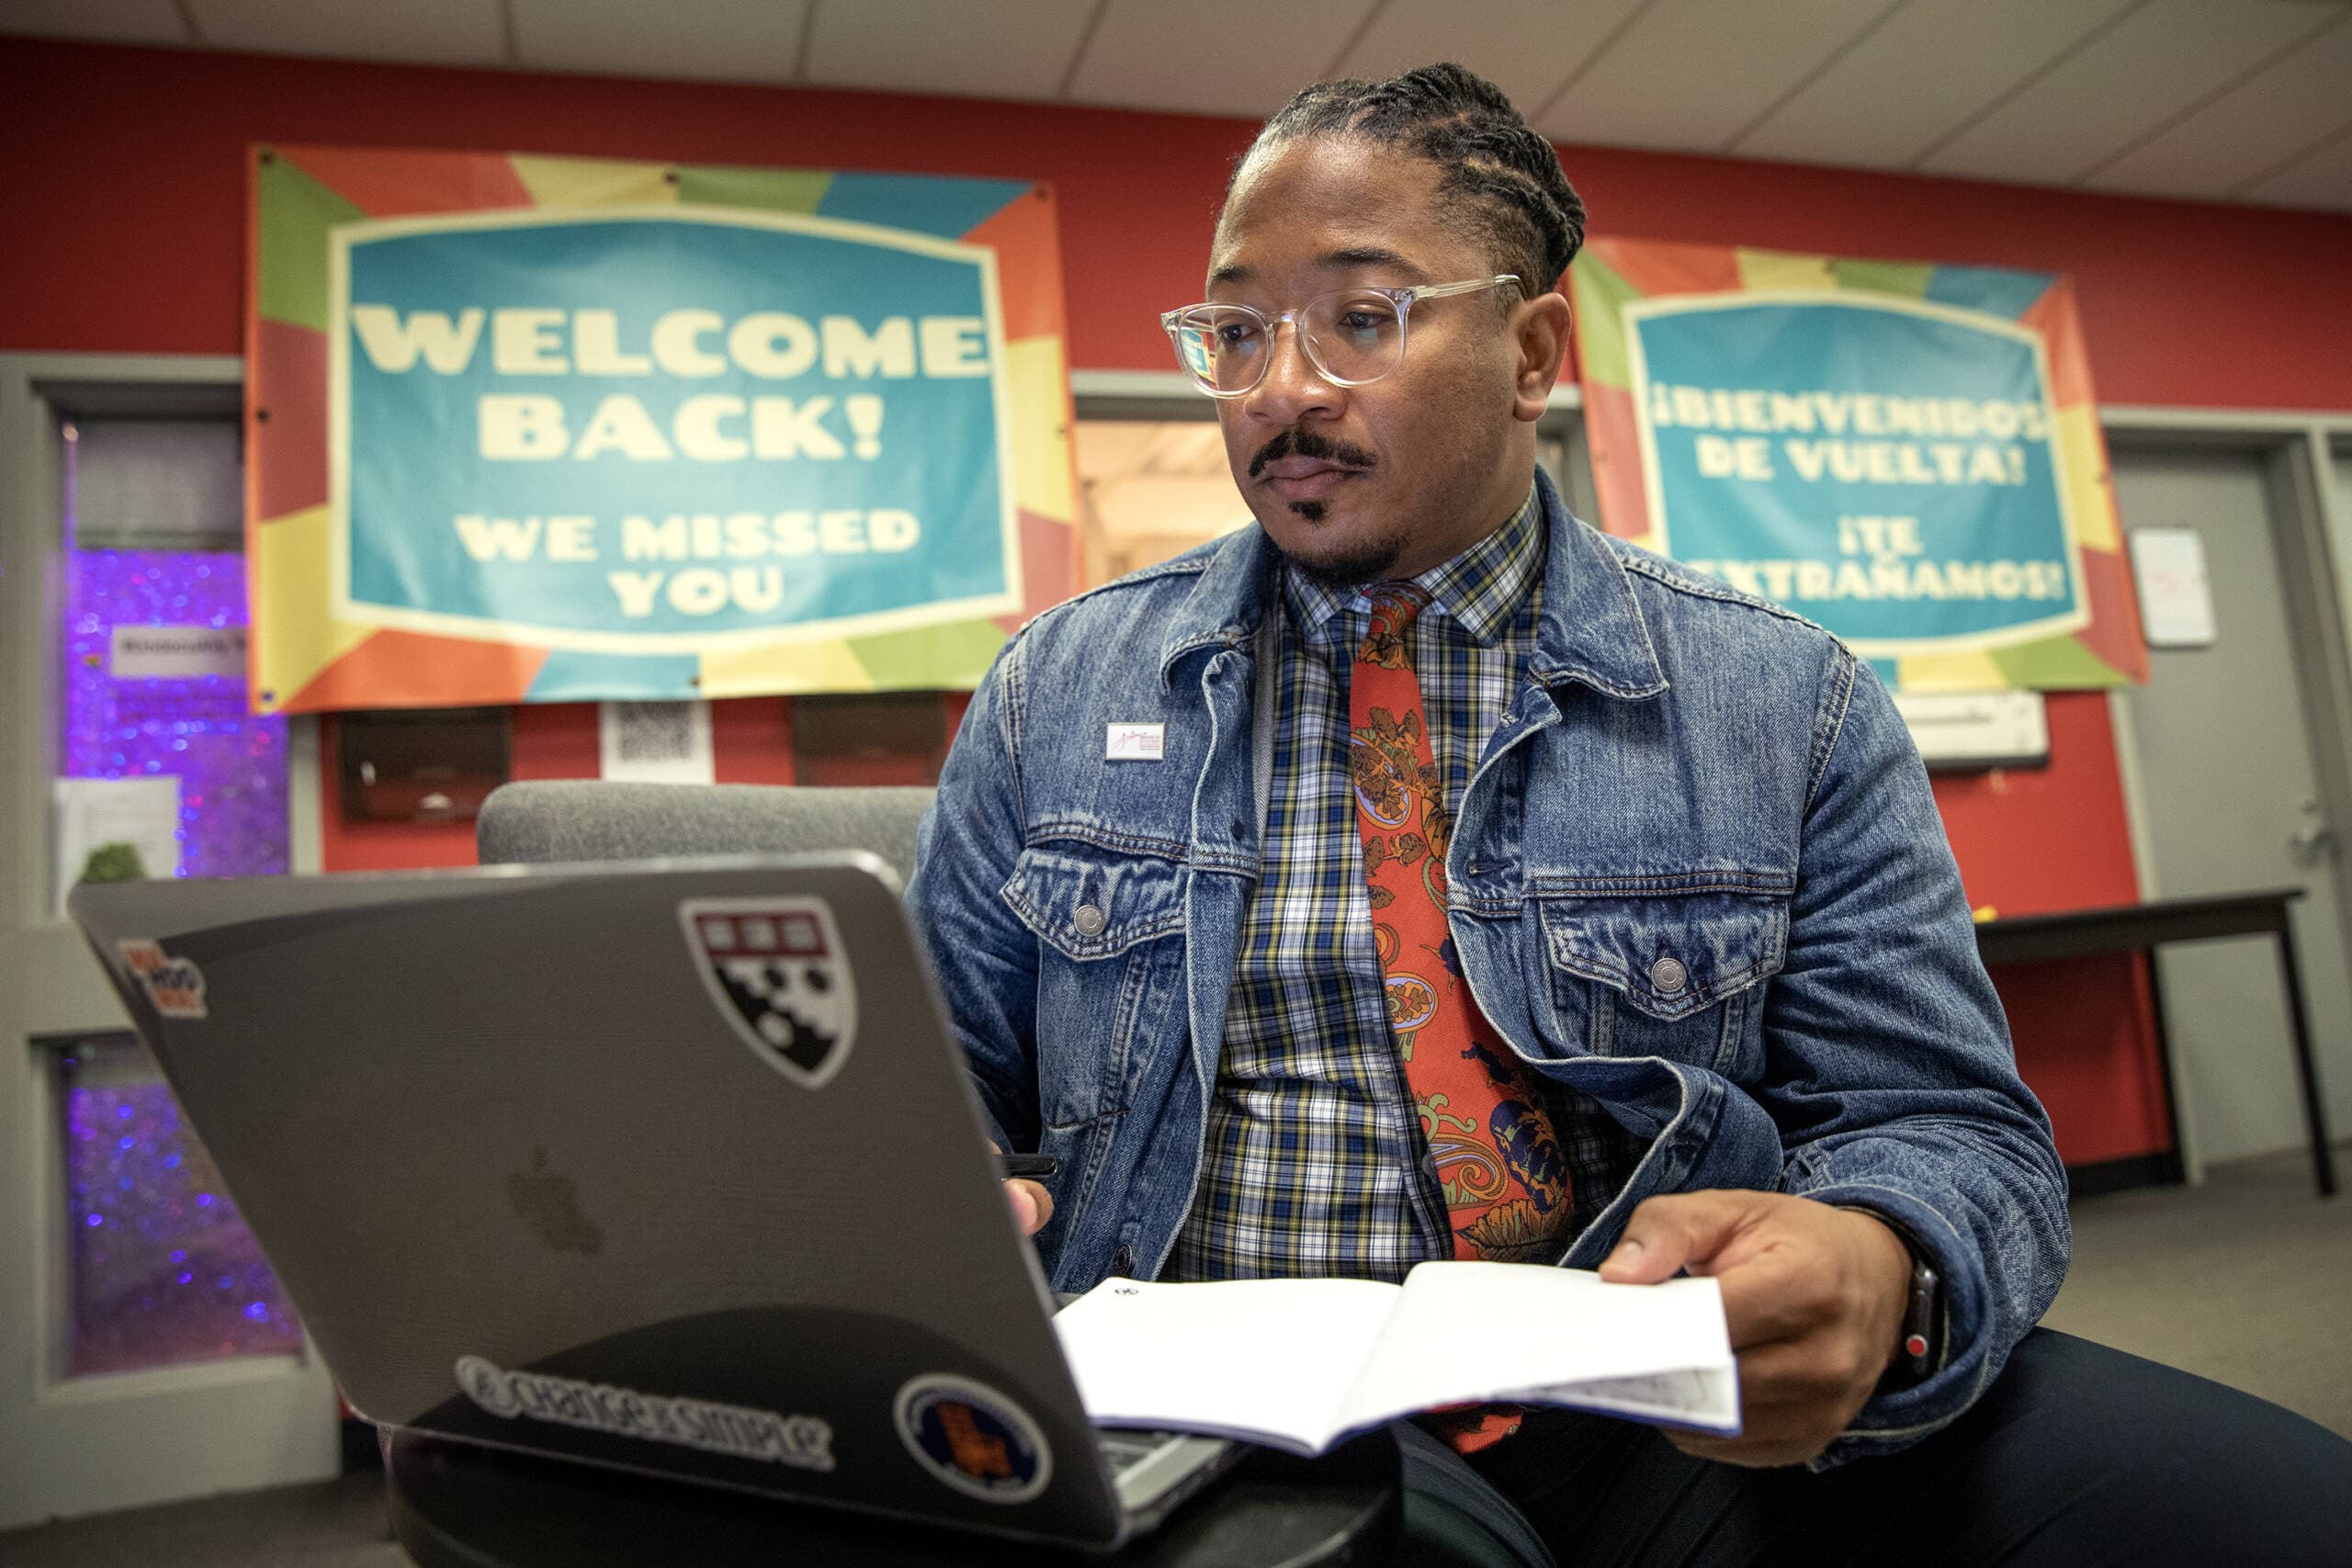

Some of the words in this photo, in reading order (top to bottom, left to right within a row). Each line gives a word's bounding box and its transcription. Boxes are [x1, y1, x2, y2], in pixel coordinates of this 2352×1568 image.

[352, 302, 988, 378] WELCOME
[477, 393, 884, 461] BACK!
[1695, 434, 1774, 480] DE
[1783, 438, 2027, 487] VUELTA!
[453, 514, 599, 563] WE
[621, 508, 921, 564] MISSED
[1838, 514, 1923, 556] ¡TE
[608, 567, 786, 618] YOU
